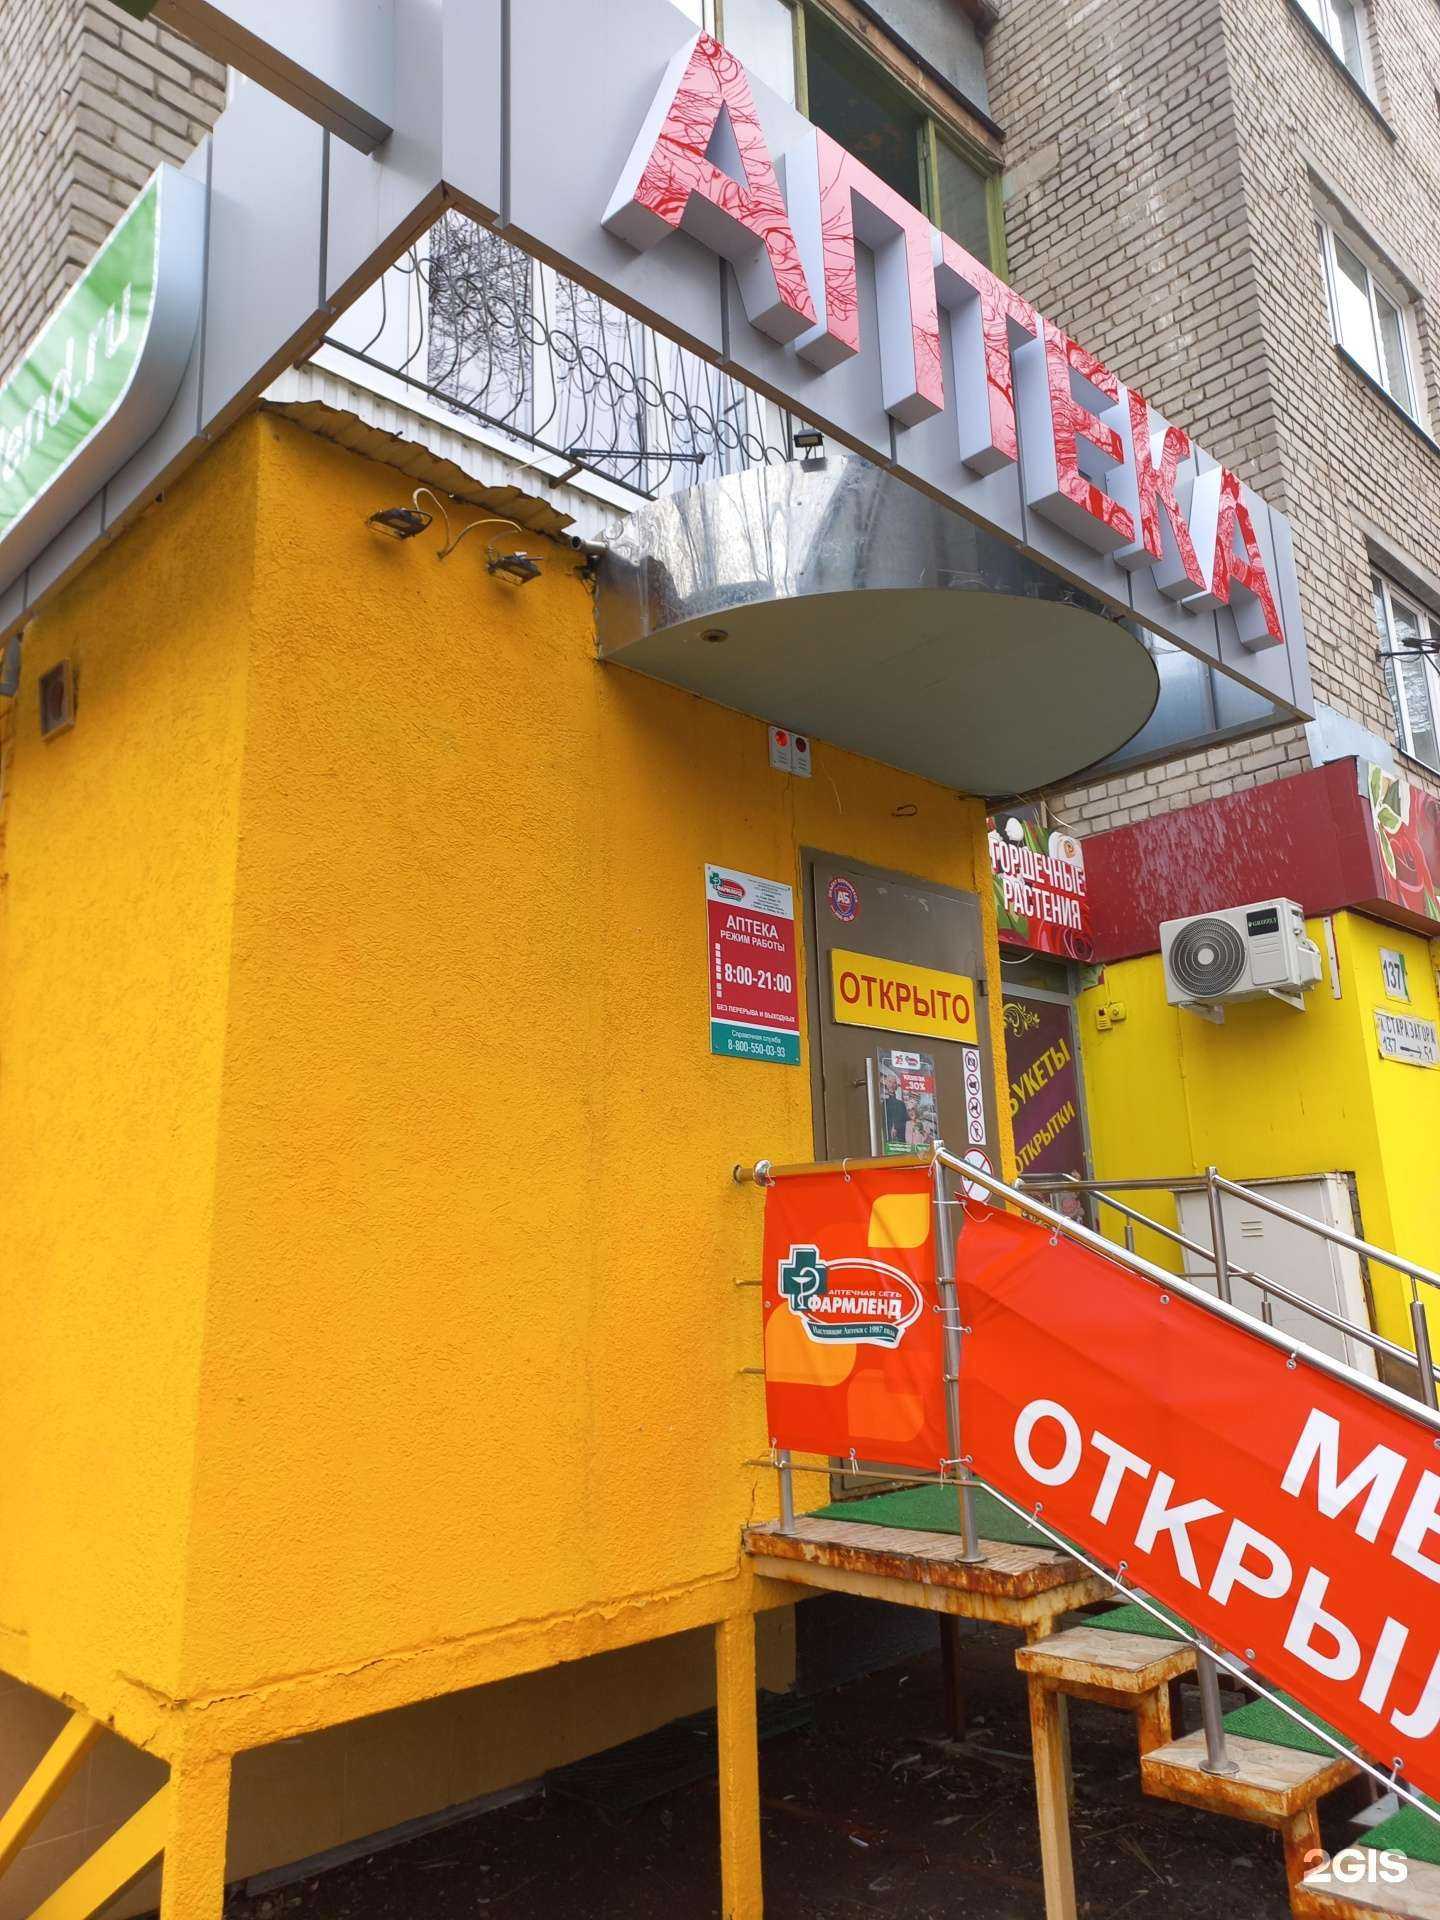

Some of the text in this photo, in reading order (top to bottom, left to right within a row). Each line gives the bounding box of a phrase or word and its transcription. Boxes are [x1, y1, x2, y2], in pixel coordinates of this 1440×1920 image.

[632, 26, 1285, 645] АПТЕКА
[989, 838, 1086, 897] ГОРШЕЧНЫЕ
[1002, 878, 1082, 931] РАСТЕНИЯ
[726, 914, 779, 939] АПТЕКА
[720, 929, 786, 953] РЕЖИМ РАБОТЫ
[724, 963, 793, 994] 8:00-21:00
[1383, 959, 1401, 990] 137
[716, 1003, 728, 1012] БЕЗ
[839, 971, 970, 1024] ОТКРЫТО
[727, 1038, 786, 1058] 8-800-550-03-93
[828, 1289, 876, 1297] АПТЕЧНАЯ
[807, 1295, 903, 1320] ФАРМЛЕНД
